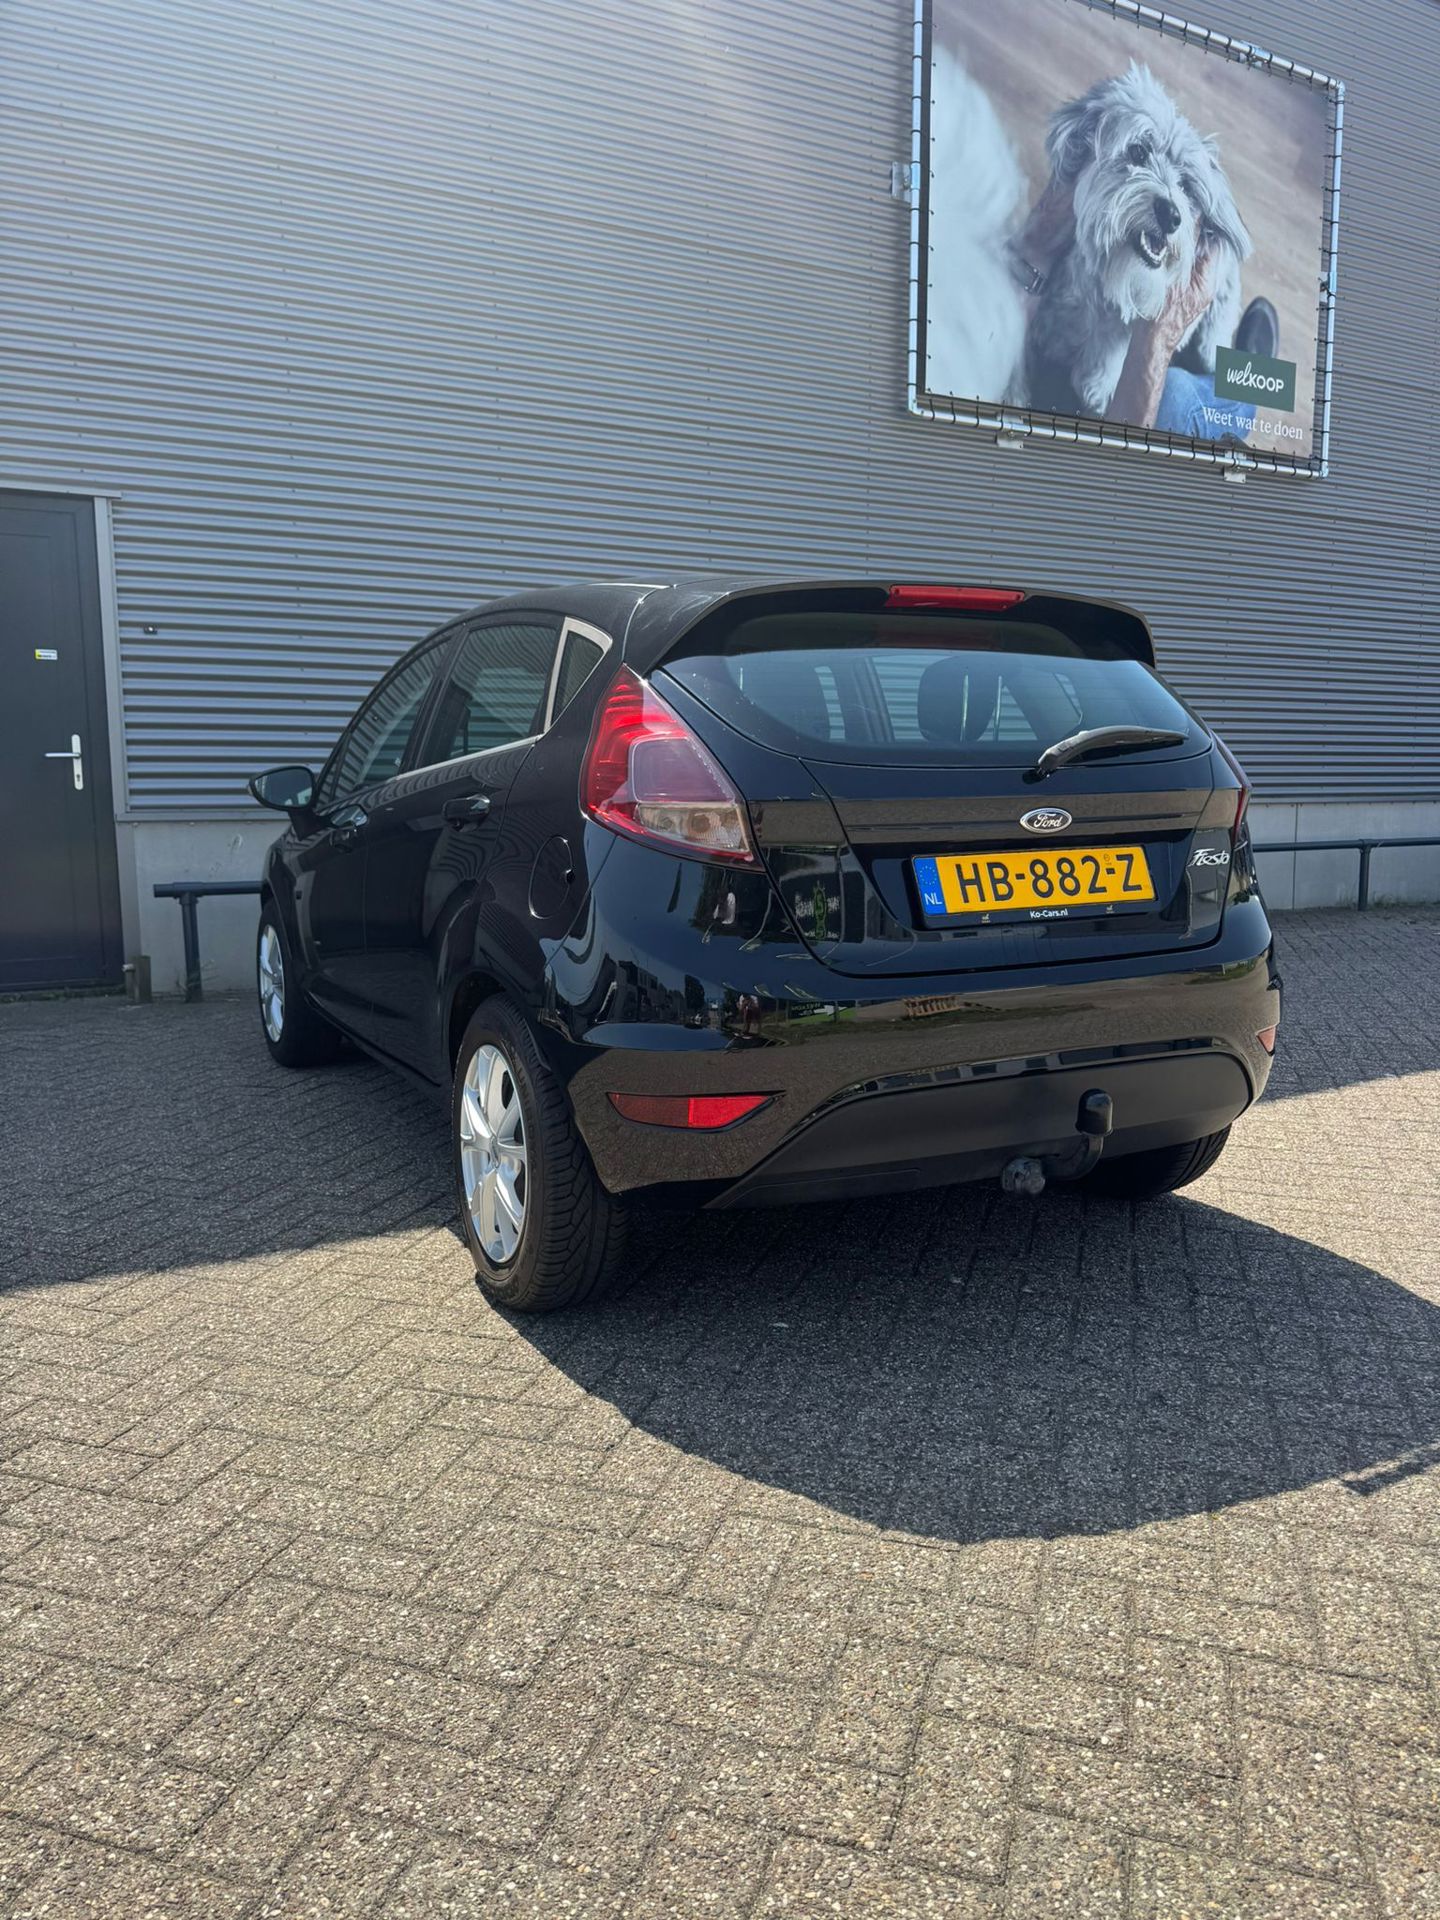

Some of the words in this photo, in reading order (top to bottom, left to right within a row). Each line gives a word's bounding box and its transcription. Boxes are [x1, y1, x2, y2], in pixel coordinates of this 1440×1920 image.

[1203, 406, 1233, 427] Weet
[1235, 415, 1257, 432] wat
[1260, 419, 1272, 434] te
[1273, 421, 1303, 440] doen
[1033, 813, 1063, 828] Ford
[1188, 848, 1230, 867] Fiesta
[955, 853, 1143, 904] HB-882-Z
[924, 894, 943, 906] NL
[1029, 908, 1068, 919] Ko-Cars.nl
